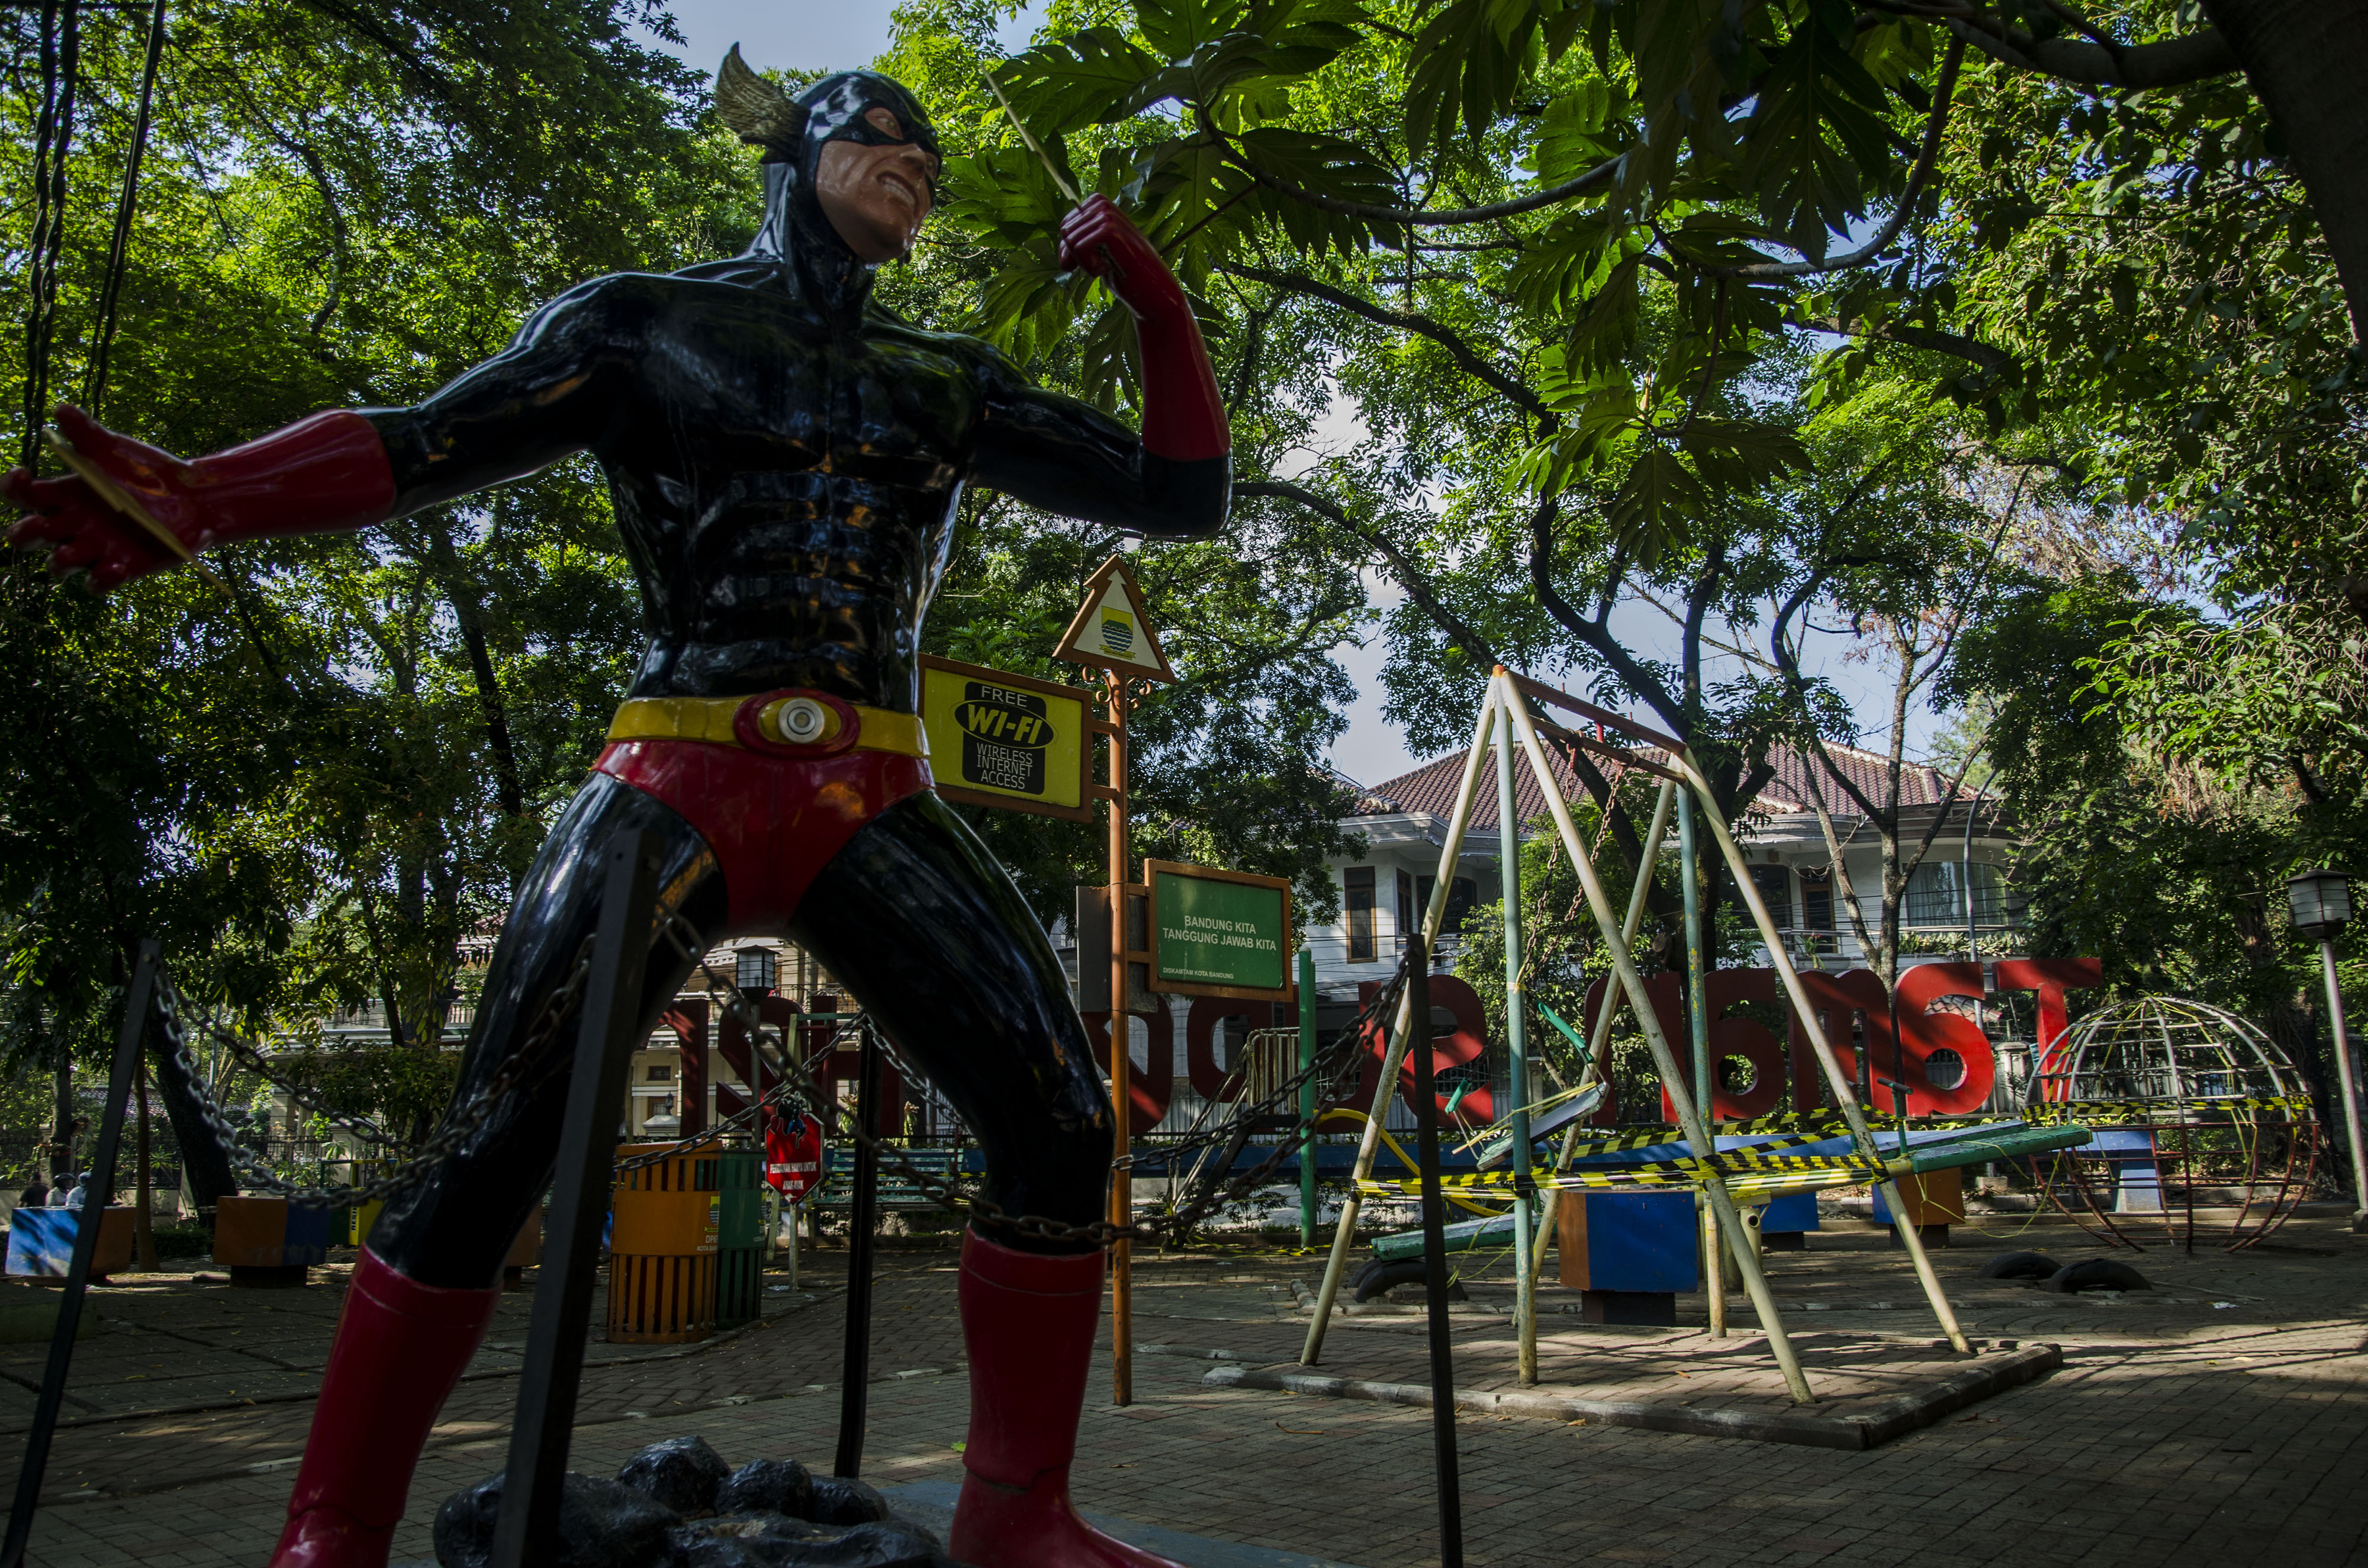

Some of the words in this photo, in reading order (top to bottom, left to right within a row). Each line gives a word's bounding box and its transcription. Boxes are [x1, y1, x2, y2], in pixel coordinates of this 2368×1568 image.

[981, 685, 1027, 707] FREE
[977, 742, 1032, 765] WIRELESS
[977, 755, 1032, 777] INTERNET
[980, 769, 1025, 790] ACCESS
[1184, 916, 1233, 932] BANDUNG
[1235, 921, 1256, 934] KITA
[1163, 928, 1218, 944] TANGGUNG
[1221, 935, 1253, 948] JAWAB
[1256, 939, 1276, 951] KITA
[1163, 967, 1193, 975] DISKAMTAM
